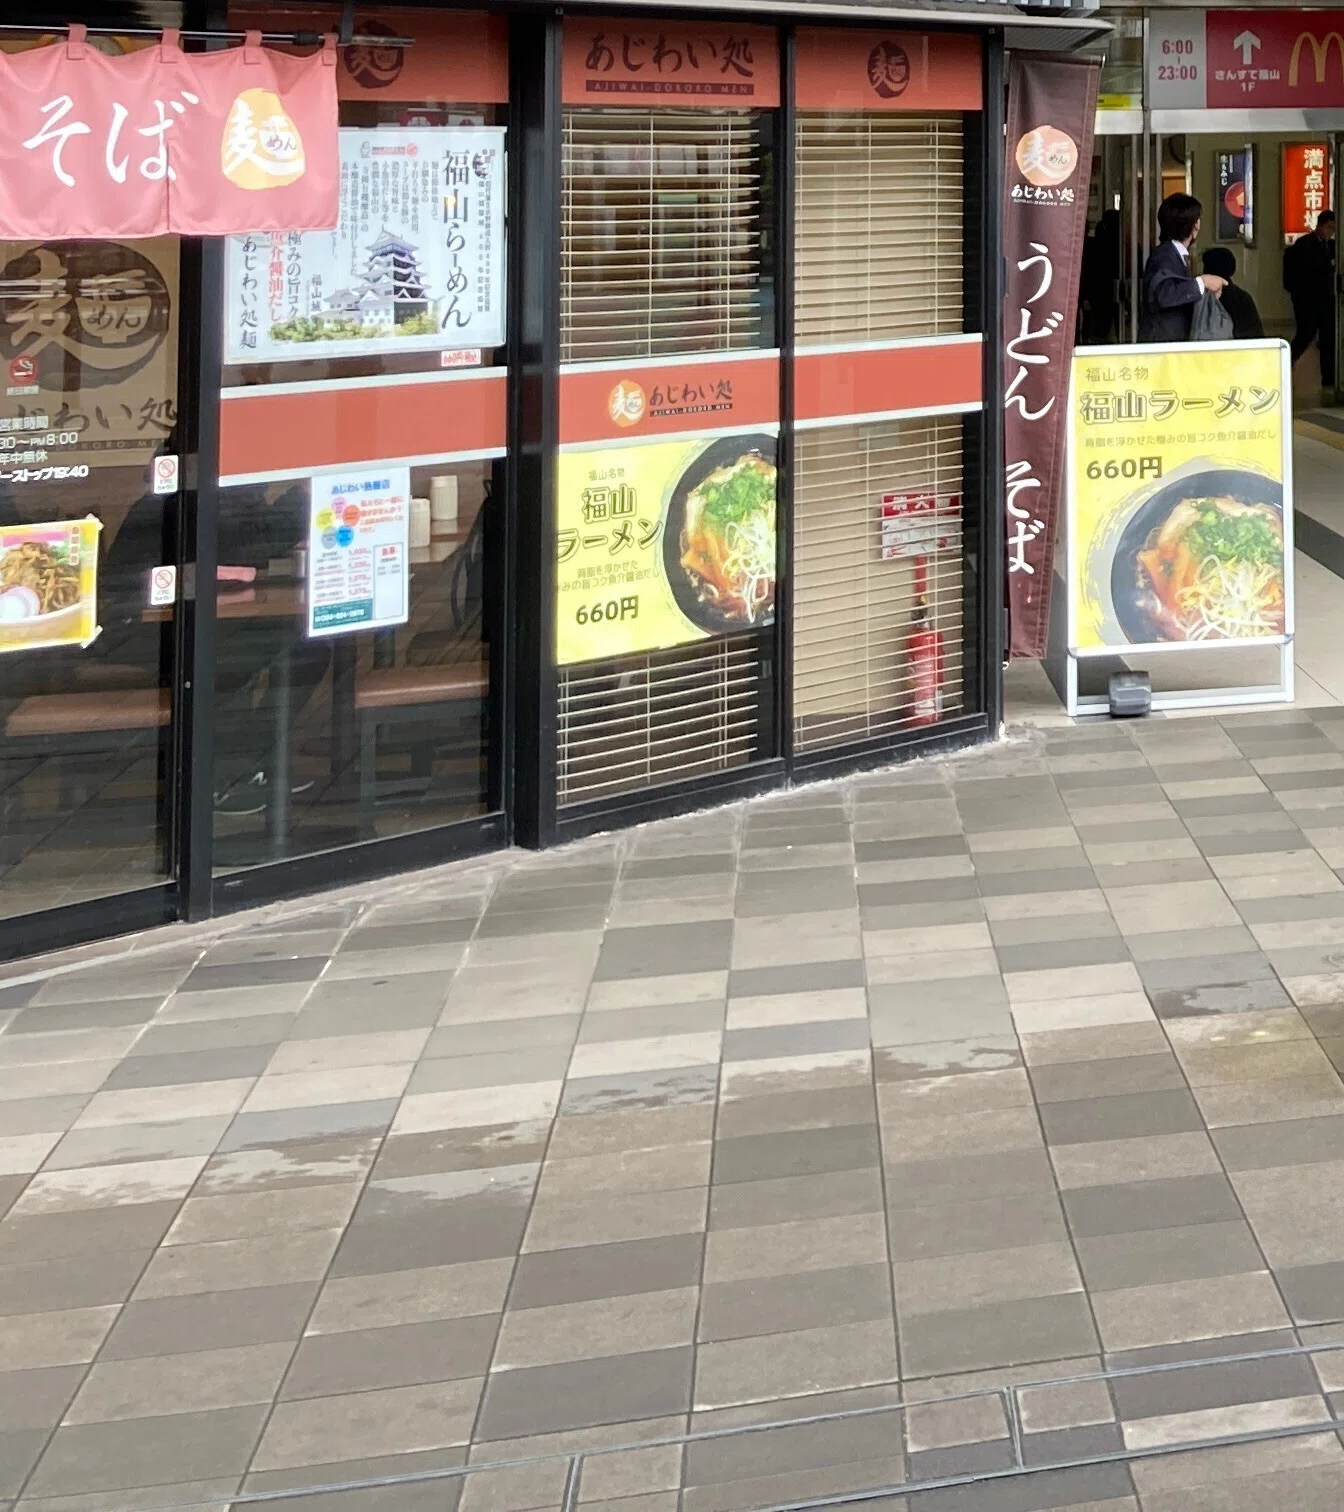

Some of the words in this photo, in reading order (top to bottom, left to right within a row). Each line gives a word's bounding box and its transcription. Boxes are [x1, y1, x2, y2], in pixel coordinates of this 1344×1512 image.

[586, 34, 754, 78] あじわい処
[1162, 39, 1193, 55] 6:00
[1158, 65, 1197, 80] 23:00
[1215, 69, 1280, 80] さんすて福山
[1241, 82, 1255, 92] 1F
[23, 91, 199, 187] そば
[1011, 184, 1075, 202] あじわい処
[441, 149, 472, 329] 福山らーめん
[1005, 242, 1064, 421] うどん
[1086, 367, 1149, 382] 福山名物
[649, 379, 733, 406] あじわい処
[1080, 386, 1280, 425] 福山ラーメン
[0, 449, 48, 465] 年中無休
[1086, 456, 1162, 479] 660円
[581, 483, 637, 524] 福山
[1006, 461, 1046, 575] そば
[557, 519, 664, 563] ラーメン
[576, 595, 639, 625] 660円
